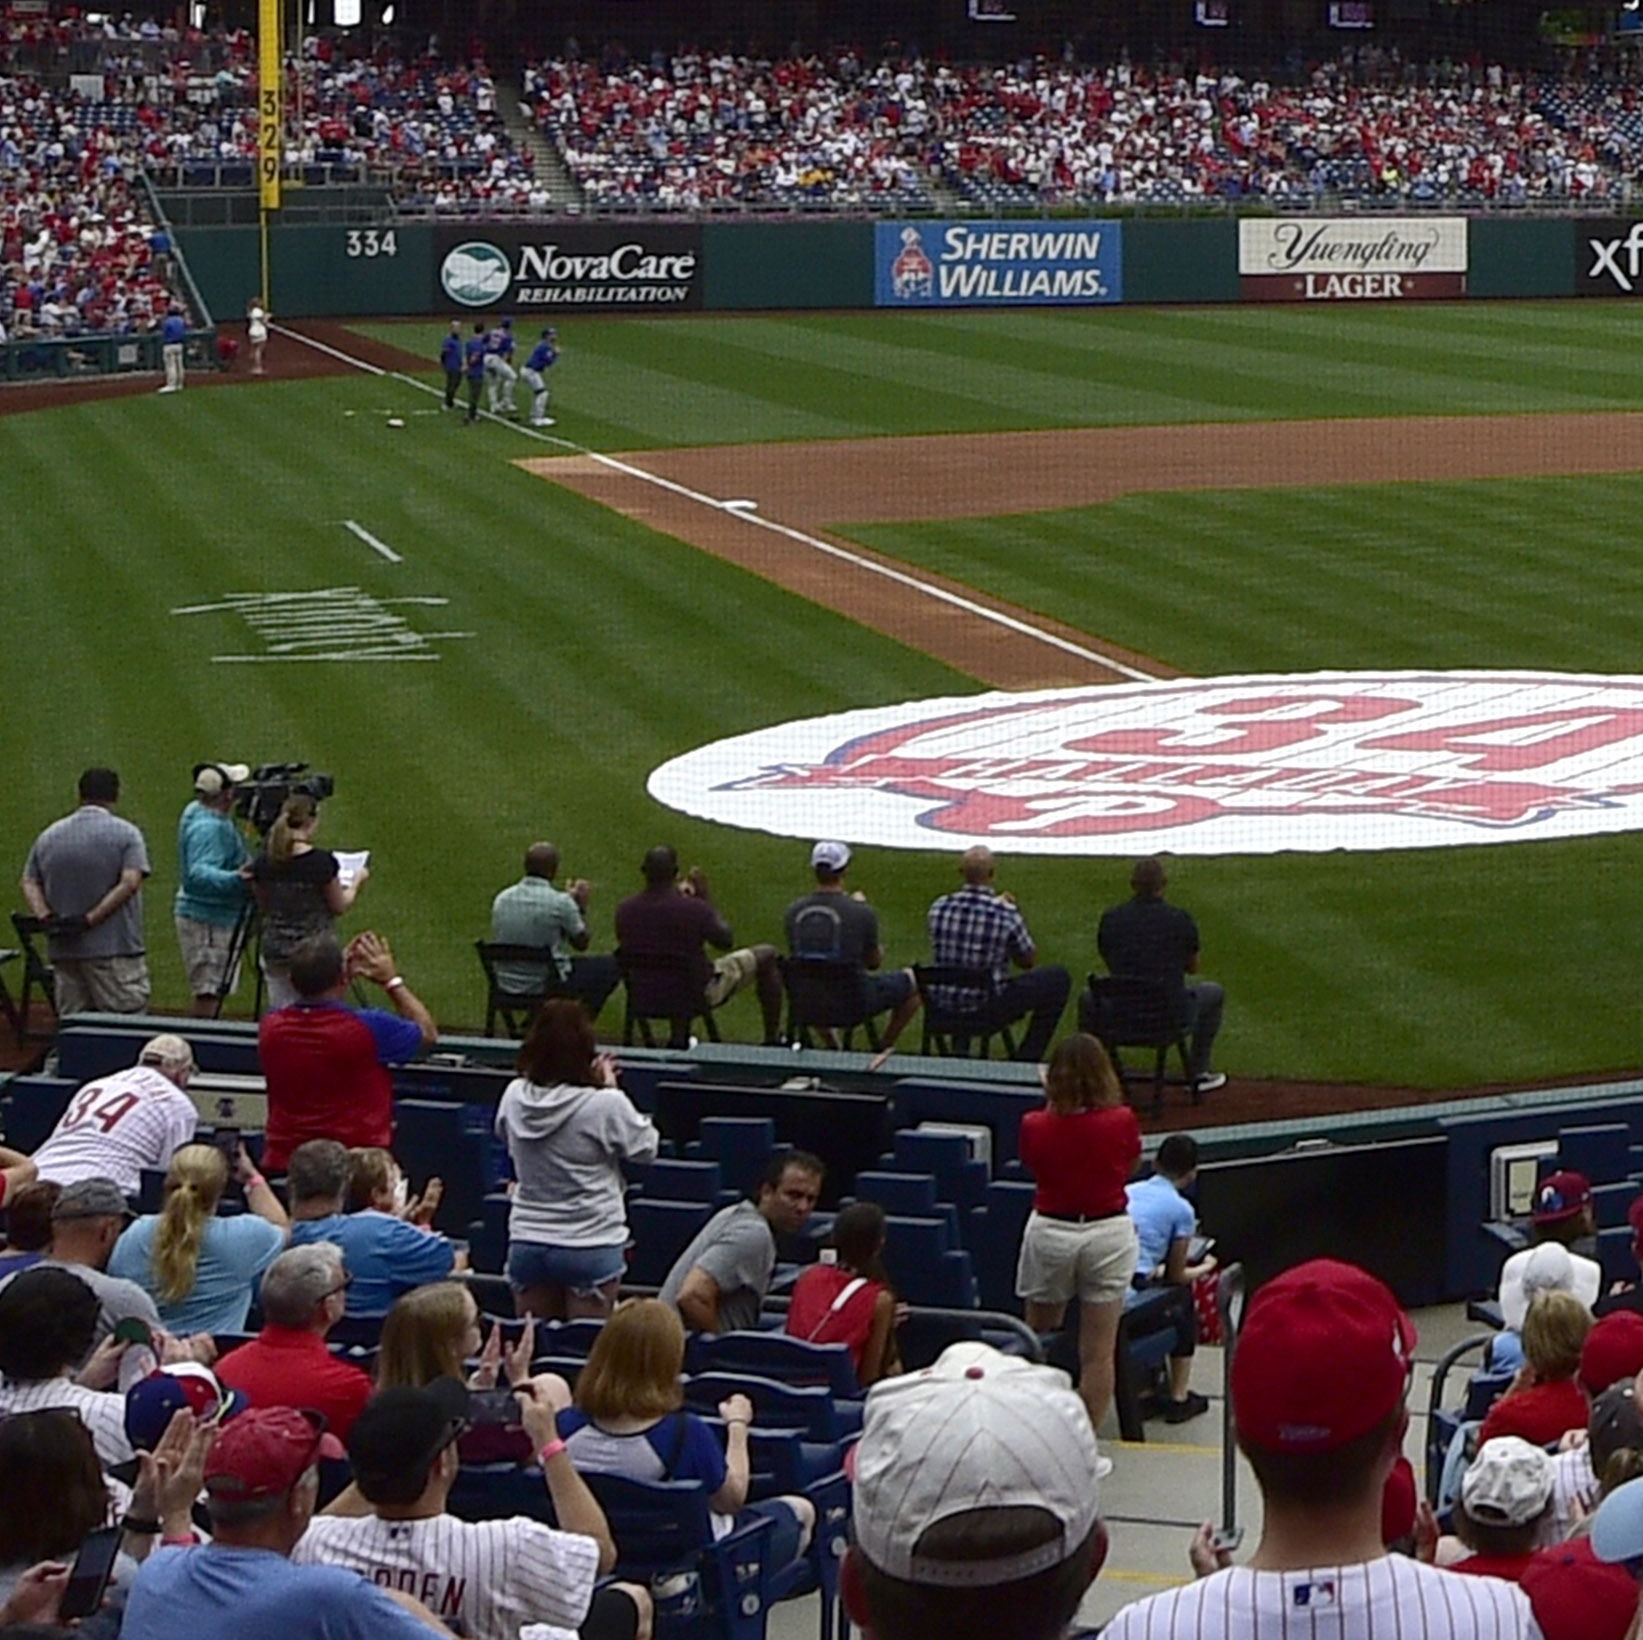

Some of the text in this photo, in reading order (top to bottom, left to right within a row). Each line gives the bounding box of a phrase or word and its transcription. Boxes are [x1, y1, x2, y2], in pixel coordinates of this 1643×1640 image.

[346, 230, 397, 258] 334
[941, 226, 1100, 261] SHERWIN
[1268, 222, 1440, 269] Yuengling
[514, 244, 694, 282] NovaCare
[940, 262, 1102, 297] WILLIAMS
[516, 285, 689, 303] REHABILITATION
[1304, 273, 1403, 299] LAGER
[62, 1087, 141, 1134] 34
